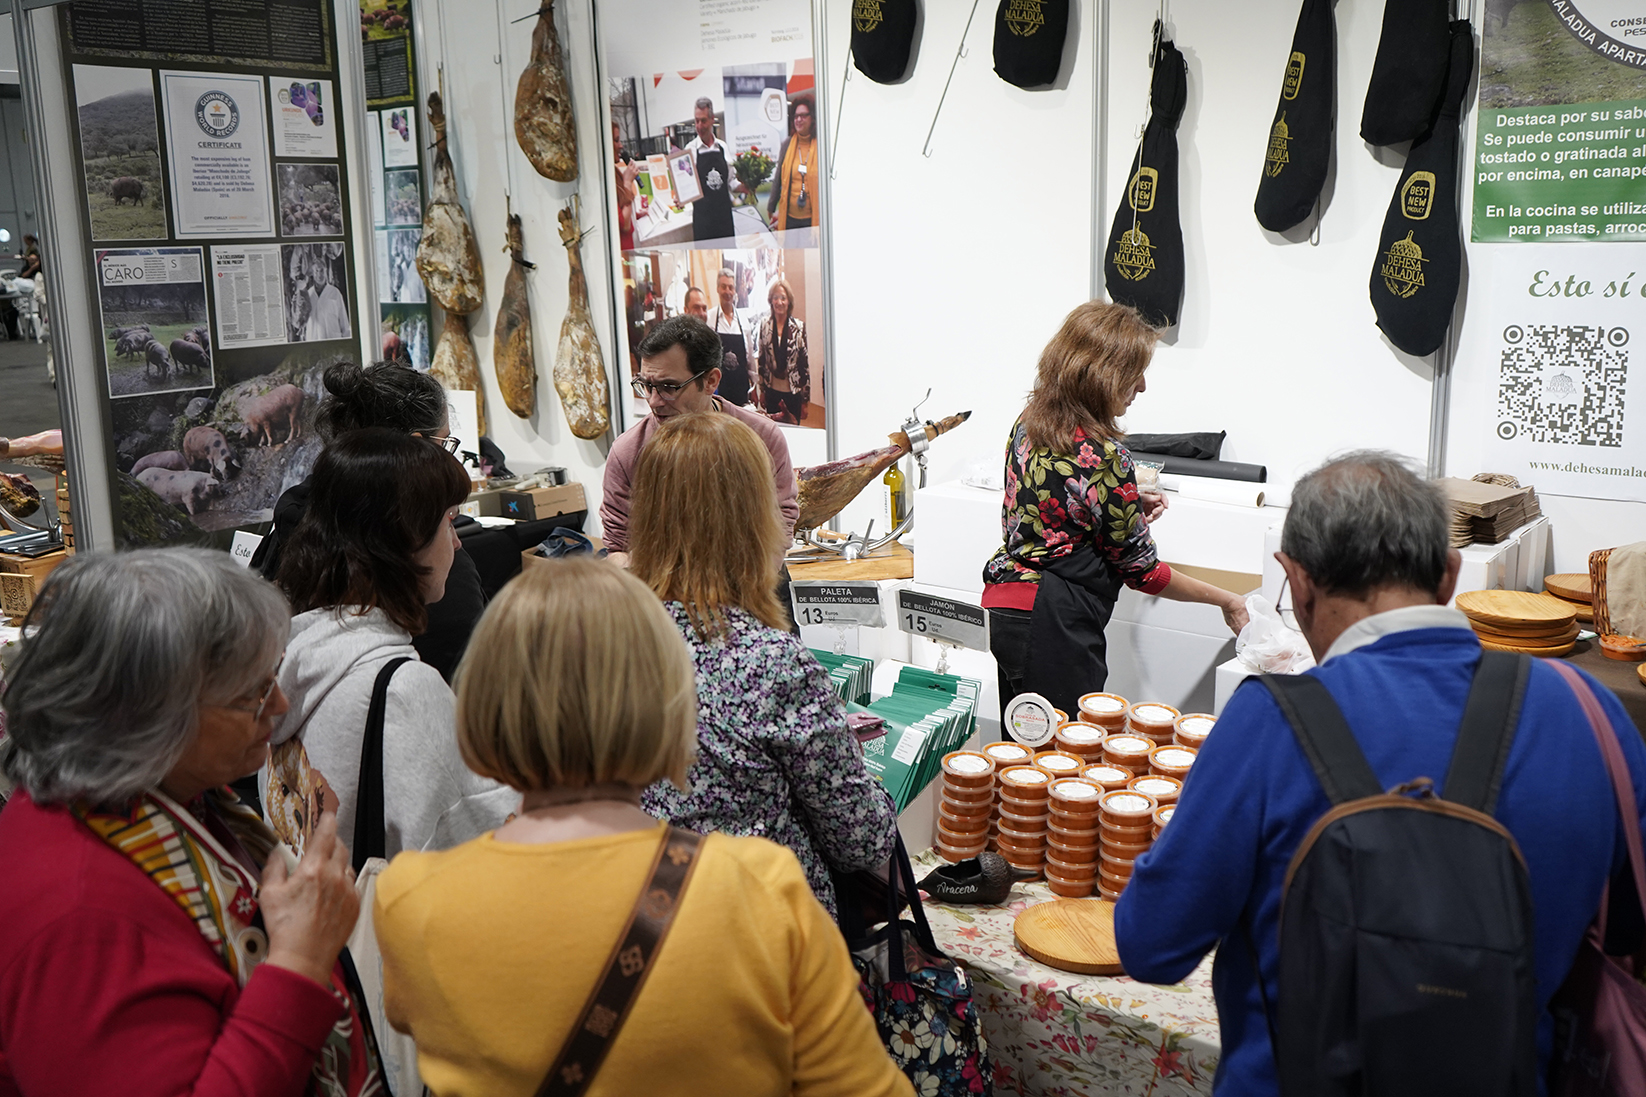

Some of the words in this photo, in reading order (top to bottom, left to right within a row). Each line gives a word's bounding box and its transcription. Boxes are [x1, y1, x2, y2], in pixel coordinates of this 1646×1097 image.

[1010, 0, 1041, 12] DEHESA
[1004, 9, 1044, 24] MALADUA
[1552, 0, 1596, 45] ALADUA
[200, 93, 233, 107] GUINNESS
[198, 111, 215, 134] WORLD
[216, 112, 238, 136] RECORDS
[1496, 114, 1556, 127] Destaca
[1560, 112, 1587, 126] por
[1591, 111, 1609, 122] su
[1614, 106, 1646, 119] sab
[1484, 134, 1502, 146] Se
[1507, 131, 1553, 147] puede
[1557, 127, 1631, 142] consumir
[198, 141, 242, 149] CERTIFICATE
[1480, 150, 1536, 164] tostado
[1541, 152, 1550, 161] o
[1554, 146, 1627, 164] gratinada
[1632, 144, 1646, 157] al
[1478, 172, 1503, 184] por
[1507, 168, 1565, 181] encima,
[1570, 168, 1588, 179] en
[1410, 186, 1429, 196] BEST
[1408, 196, 1427, 207] NEW
[1486, 205, 1504, 217] En
[1509, 205, 1521, 217] la
[1526, 204, 1576, 217] cocina
[1580, 205, 1598, 215] se
[1509, 224, 1541, 237] para
[1545, 222, 1600, 237] pastas,
[1605, 223, 1646, 234] arroc
[1119, 243, 1151, 257] DEHESA
[171, 259, 177, 268] S
[1113, 252, 1156, 269] MALADUA
[1387, 254, 1422, 271] DEHESA
[105, 267, 143, 280] CARO
[1381, 264, 1425, 286] MALADUA
[1529, 270, 1594, 298] Esto
[1603, 272, 1636, 298] sí
[1546, 386, 1577, 394] MALADUA
[930, 600, 955, 610] JAMÓN
[802, 608, 823, 624] 13
[914, 604, 942, 615] BELLOTA
[942, 610, 957, 618] 100%
[958, 614, 982, 625] IBÉRICO
[906, 614, 927, 632] 15
[936, 882, 978, 894] Aracena
